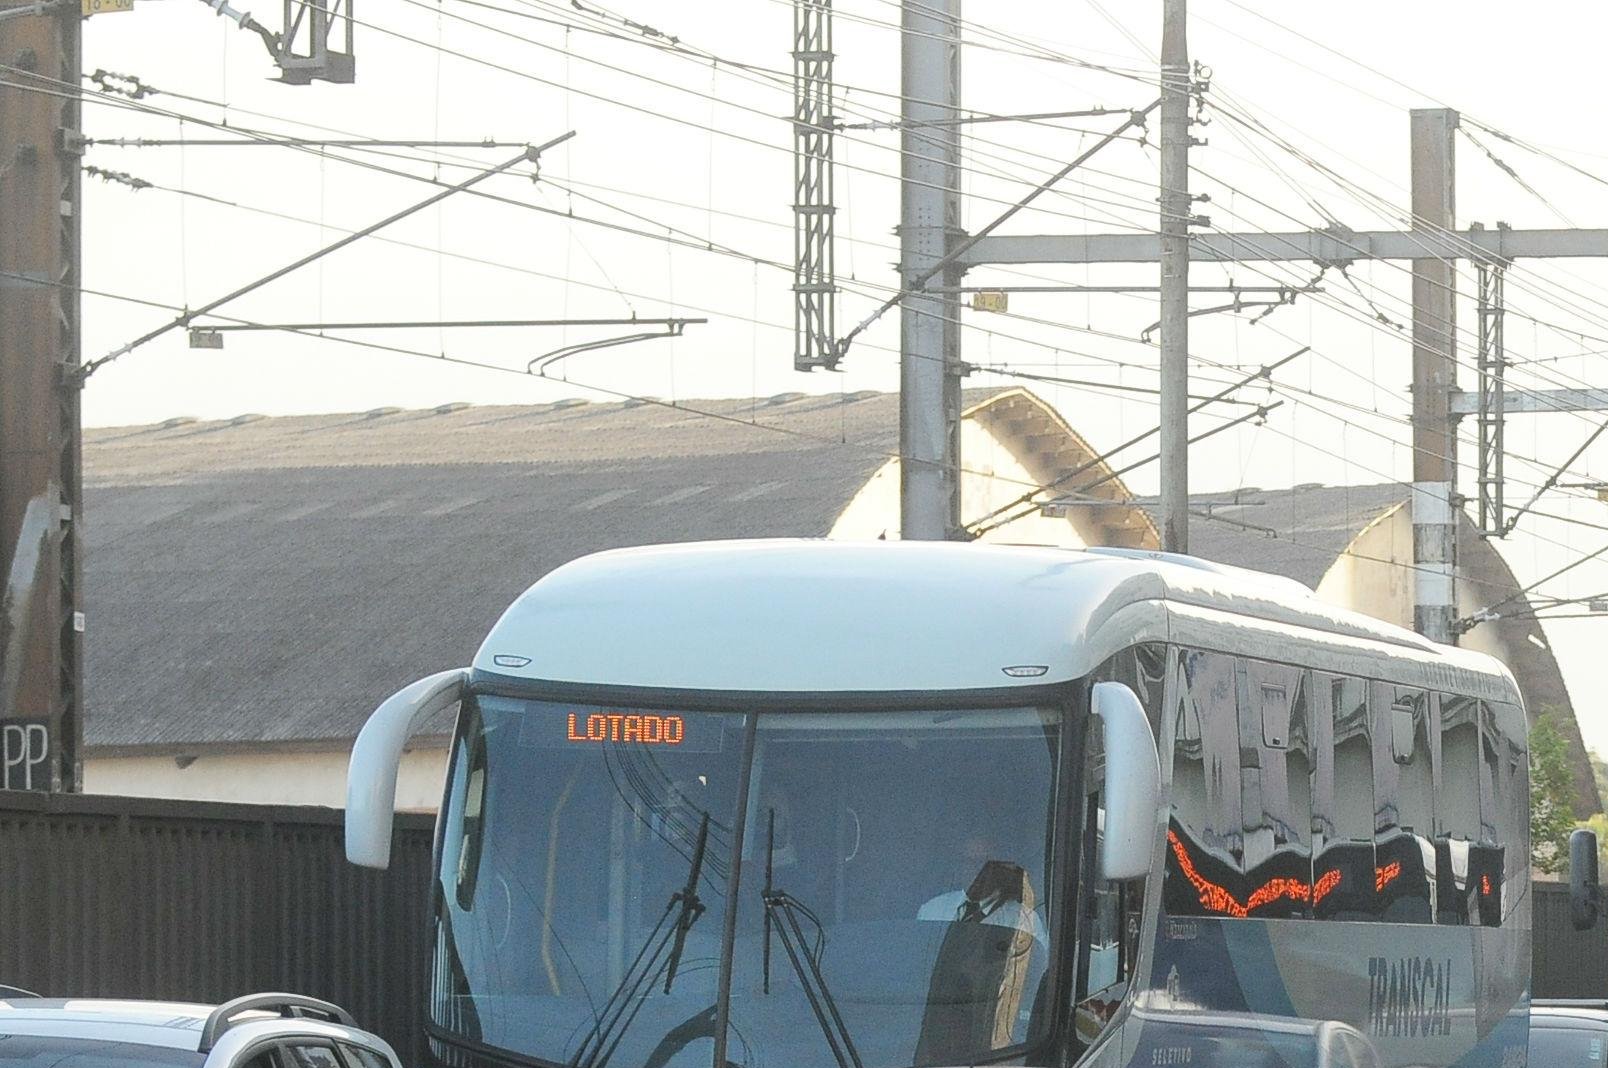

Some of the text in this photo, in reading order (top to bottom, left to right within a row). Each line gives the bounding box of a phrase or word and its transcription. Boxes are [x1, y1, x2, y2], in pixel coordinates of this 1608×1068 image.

[568, 712, 684, 744] LOTADO
[1368, 956, 1451, 1038] TRANSCAL
[1152, 1048, 1192, 1065] SELETIVO
